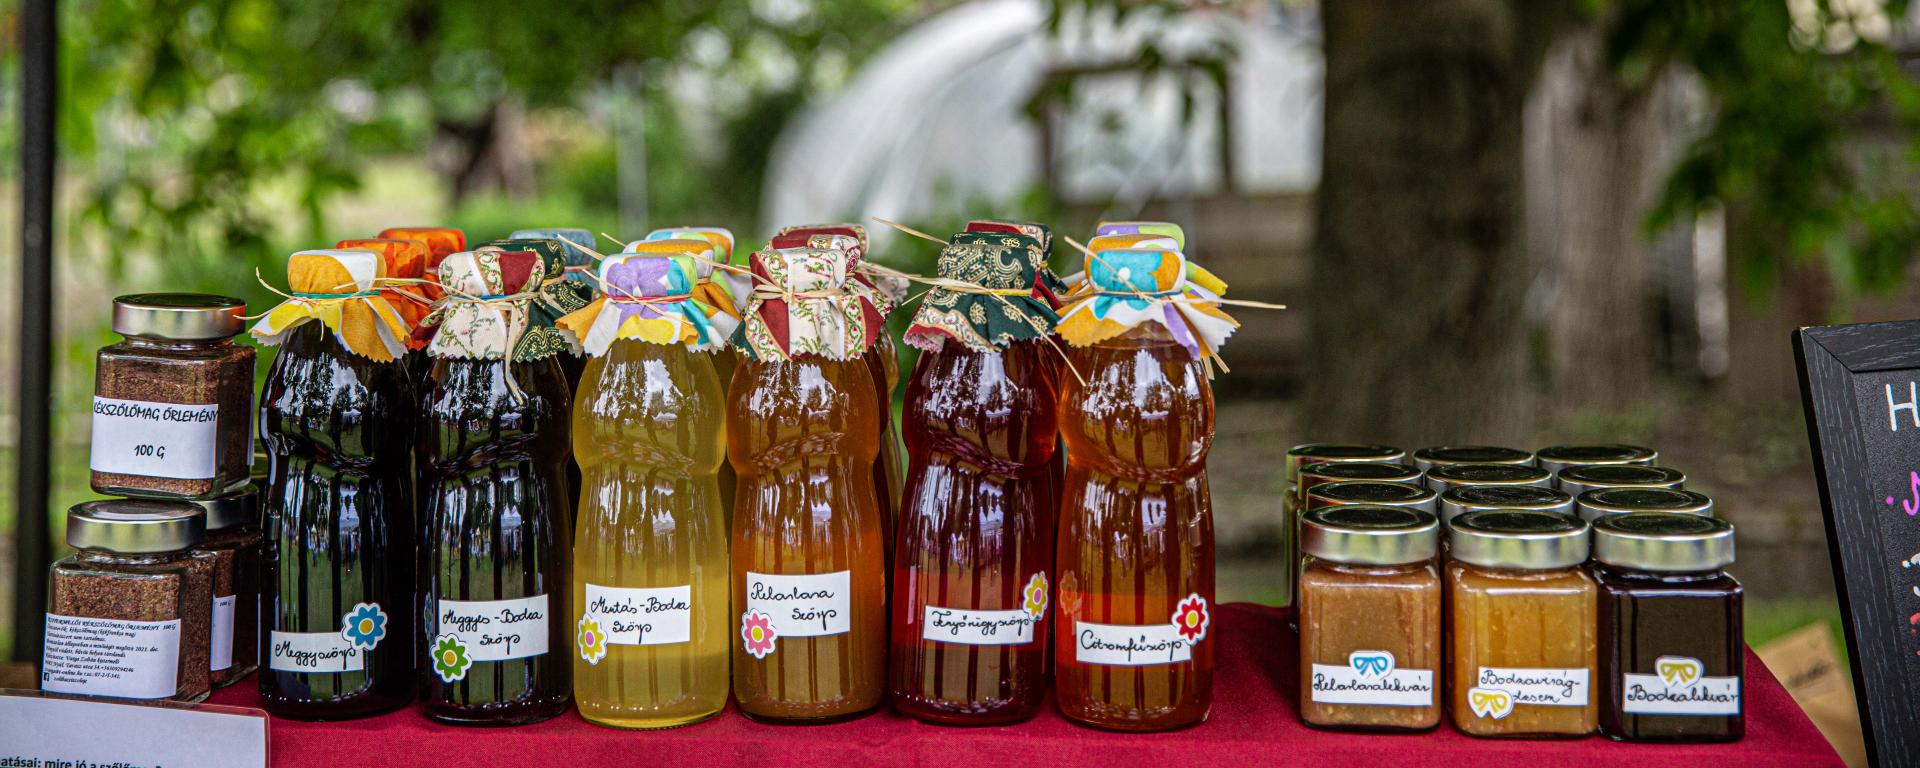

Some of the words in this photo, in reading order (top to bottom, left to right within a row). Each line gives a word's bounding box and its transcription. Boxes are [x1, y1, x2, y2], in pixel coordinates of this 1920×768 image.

[163, 407, 218, 422] ŐRLEMÉNY
[134, 444, 154, 457] 100
[156, 446, 165, 459] G
[0, 755, 41, 768] atásai:
[44, 757, 73, 768] mire
